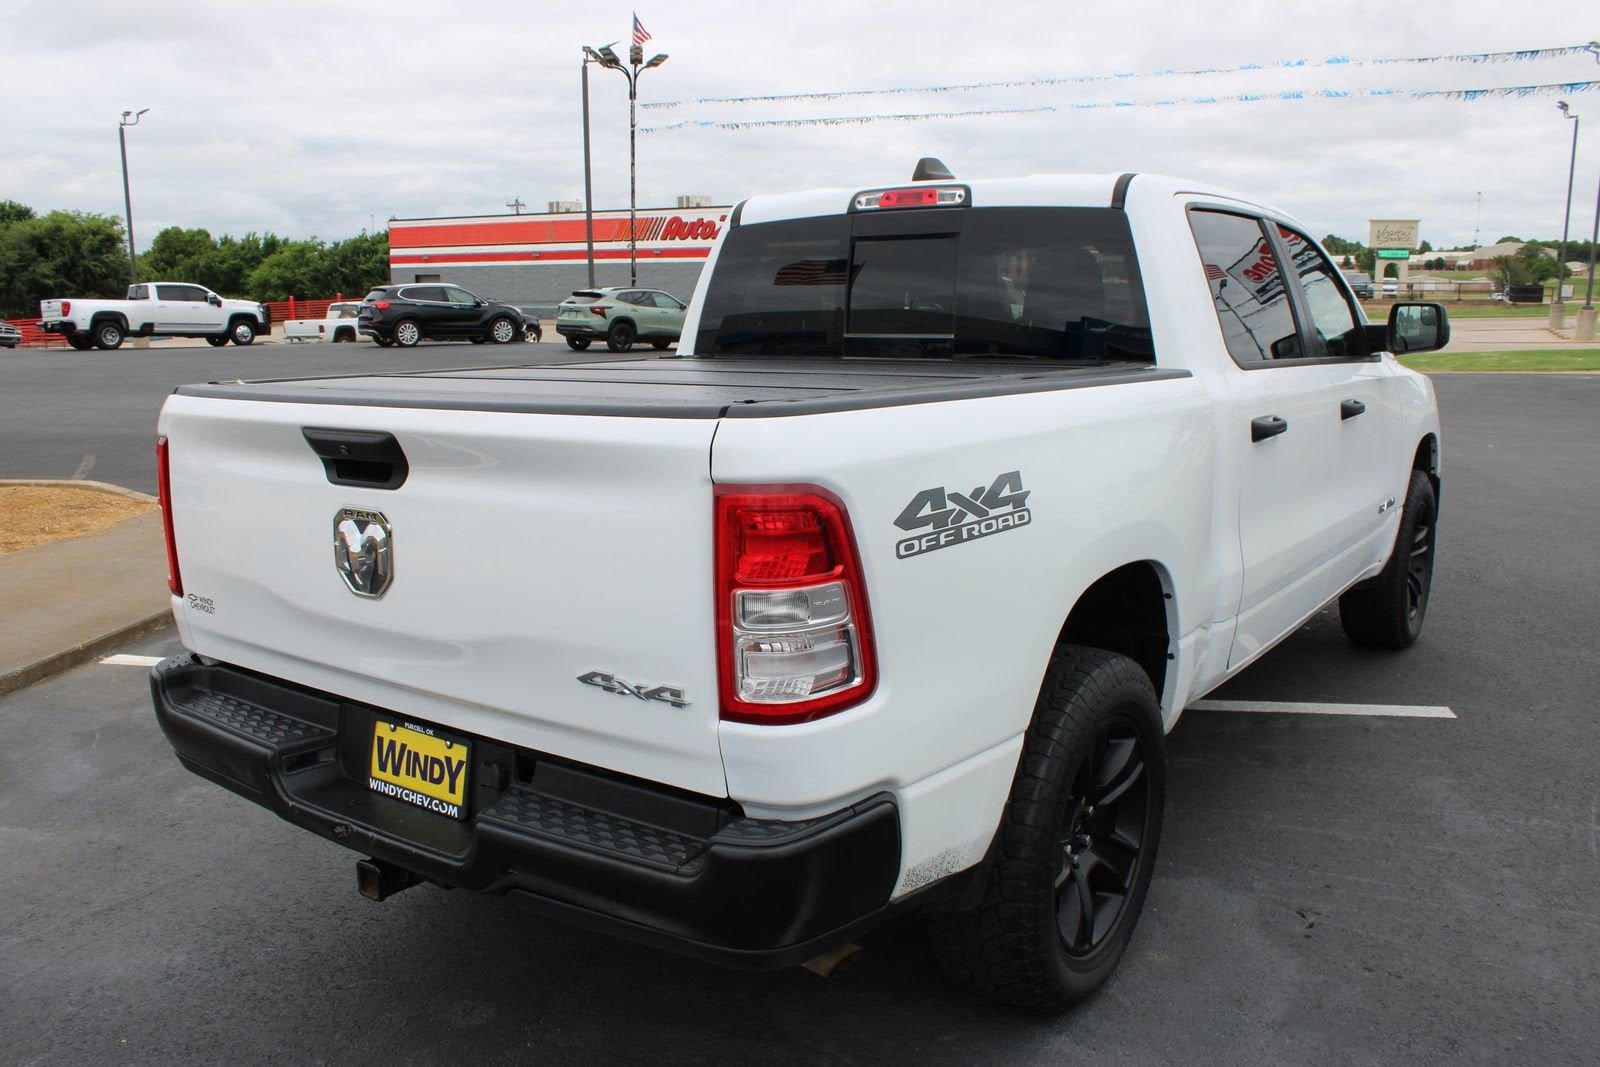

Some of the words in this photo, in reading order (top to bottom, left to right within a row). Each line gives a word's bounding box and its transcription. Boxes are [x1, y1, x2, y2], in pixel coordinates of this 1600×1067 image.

[343, 508, 378, 521] RAM
[899, 529, 956, 556] OFF
[961, 511, 1029, 539] ROAD
[425, 728, 434, 736] OK
[376, 735, 466, 795] WINDY
[369, 777, 459, 818] WINDYCHEV.COM
